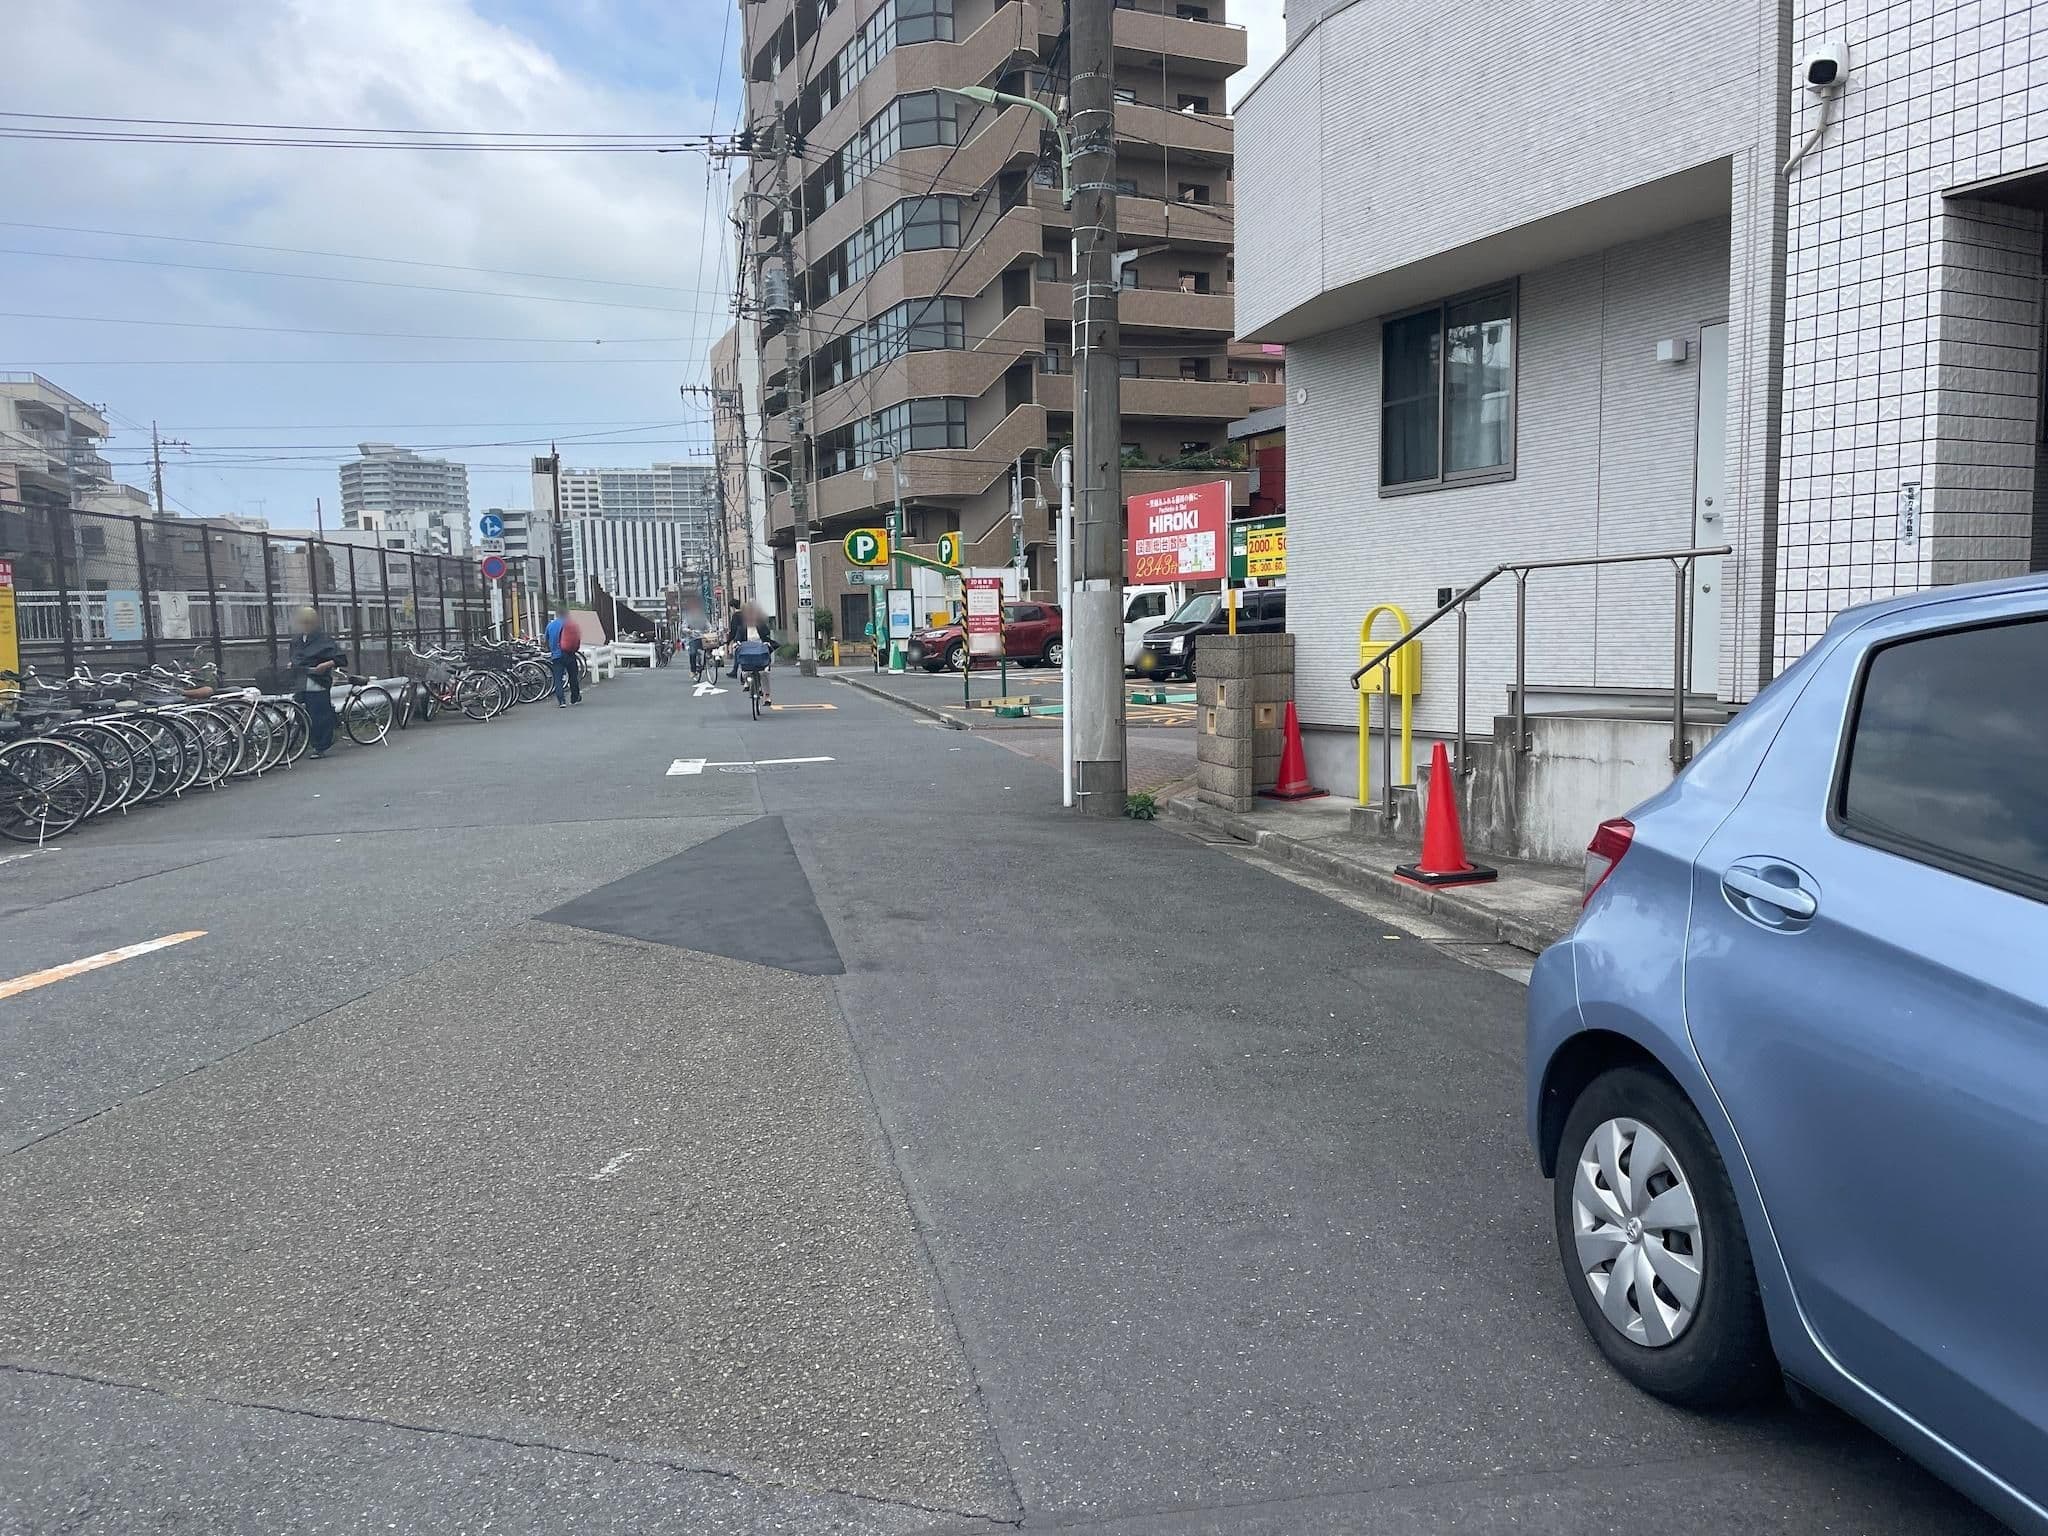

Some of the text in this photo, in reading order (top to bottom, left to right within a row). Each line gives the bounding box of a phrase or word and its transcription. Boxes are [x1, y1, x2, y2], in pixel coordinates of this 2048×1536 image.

[1149, 510, 1198, 534] HIROKI
[857, 536, 874, 559] P
[941, 541, 950, 562] P
